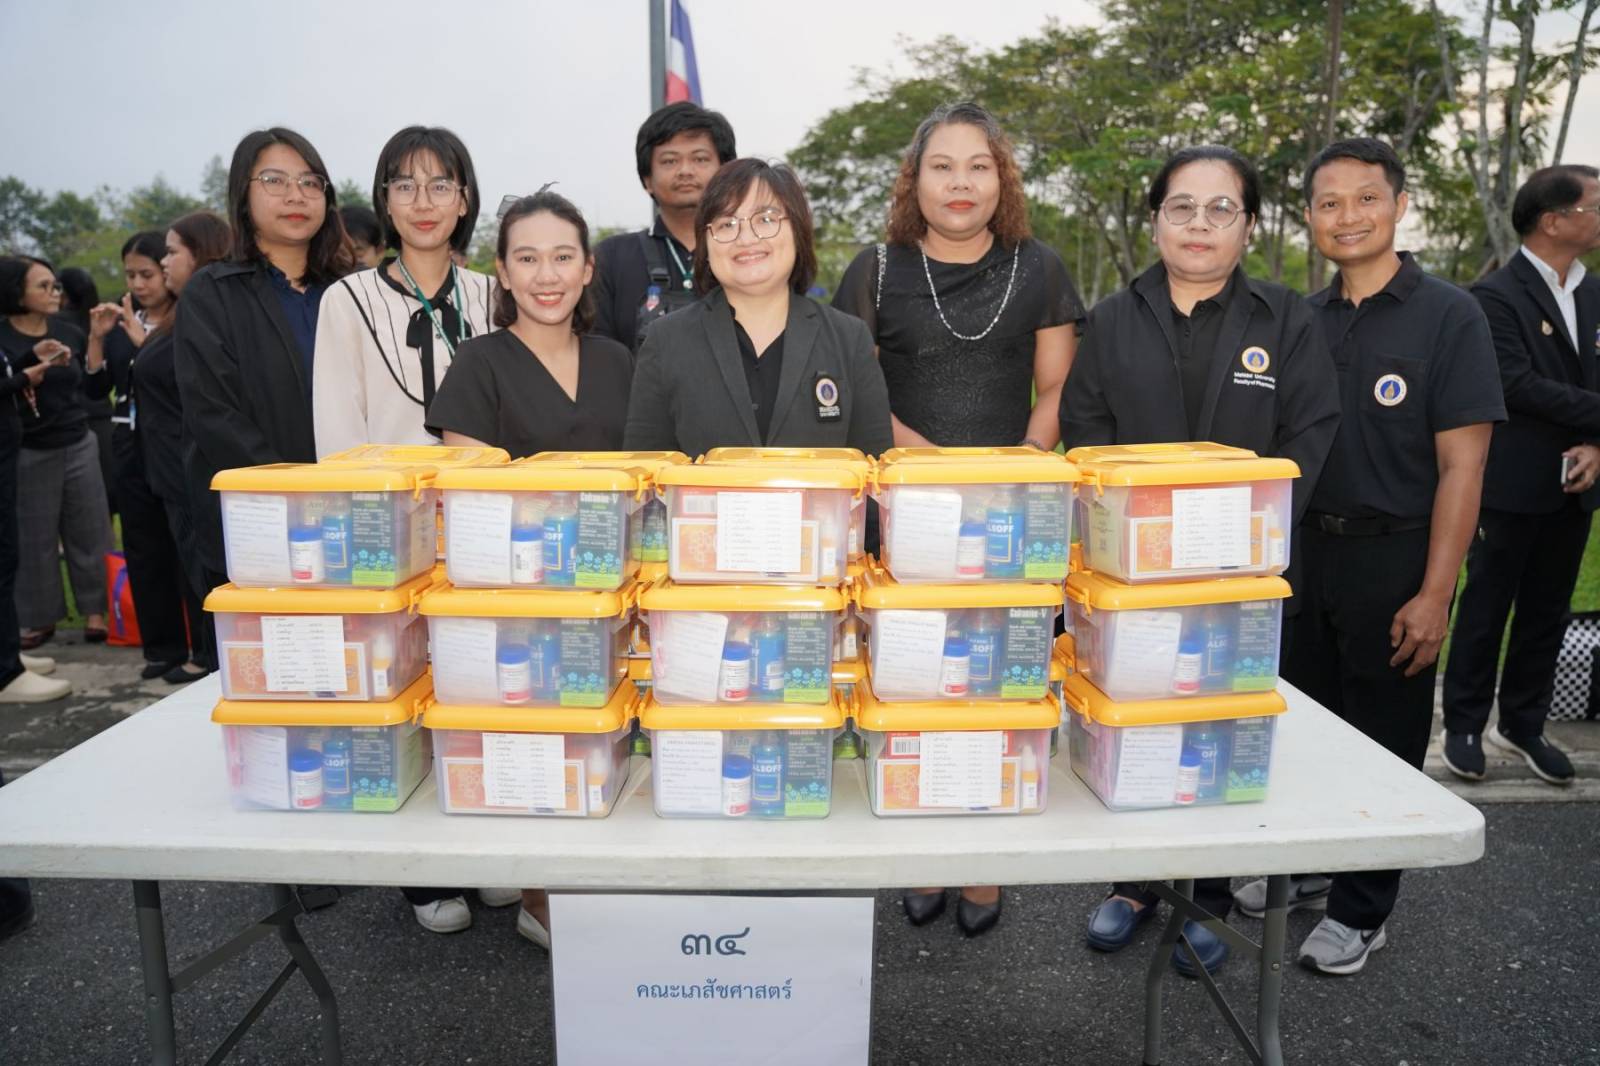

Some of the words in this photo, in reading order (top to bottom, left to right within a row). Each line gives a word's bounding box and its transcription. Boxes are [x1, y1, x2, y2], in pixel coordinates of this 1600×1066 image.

[681, 926, 751, 955] ๓๔
[636, 977, 792, 1000] คณะเภสัชศาสตร์
